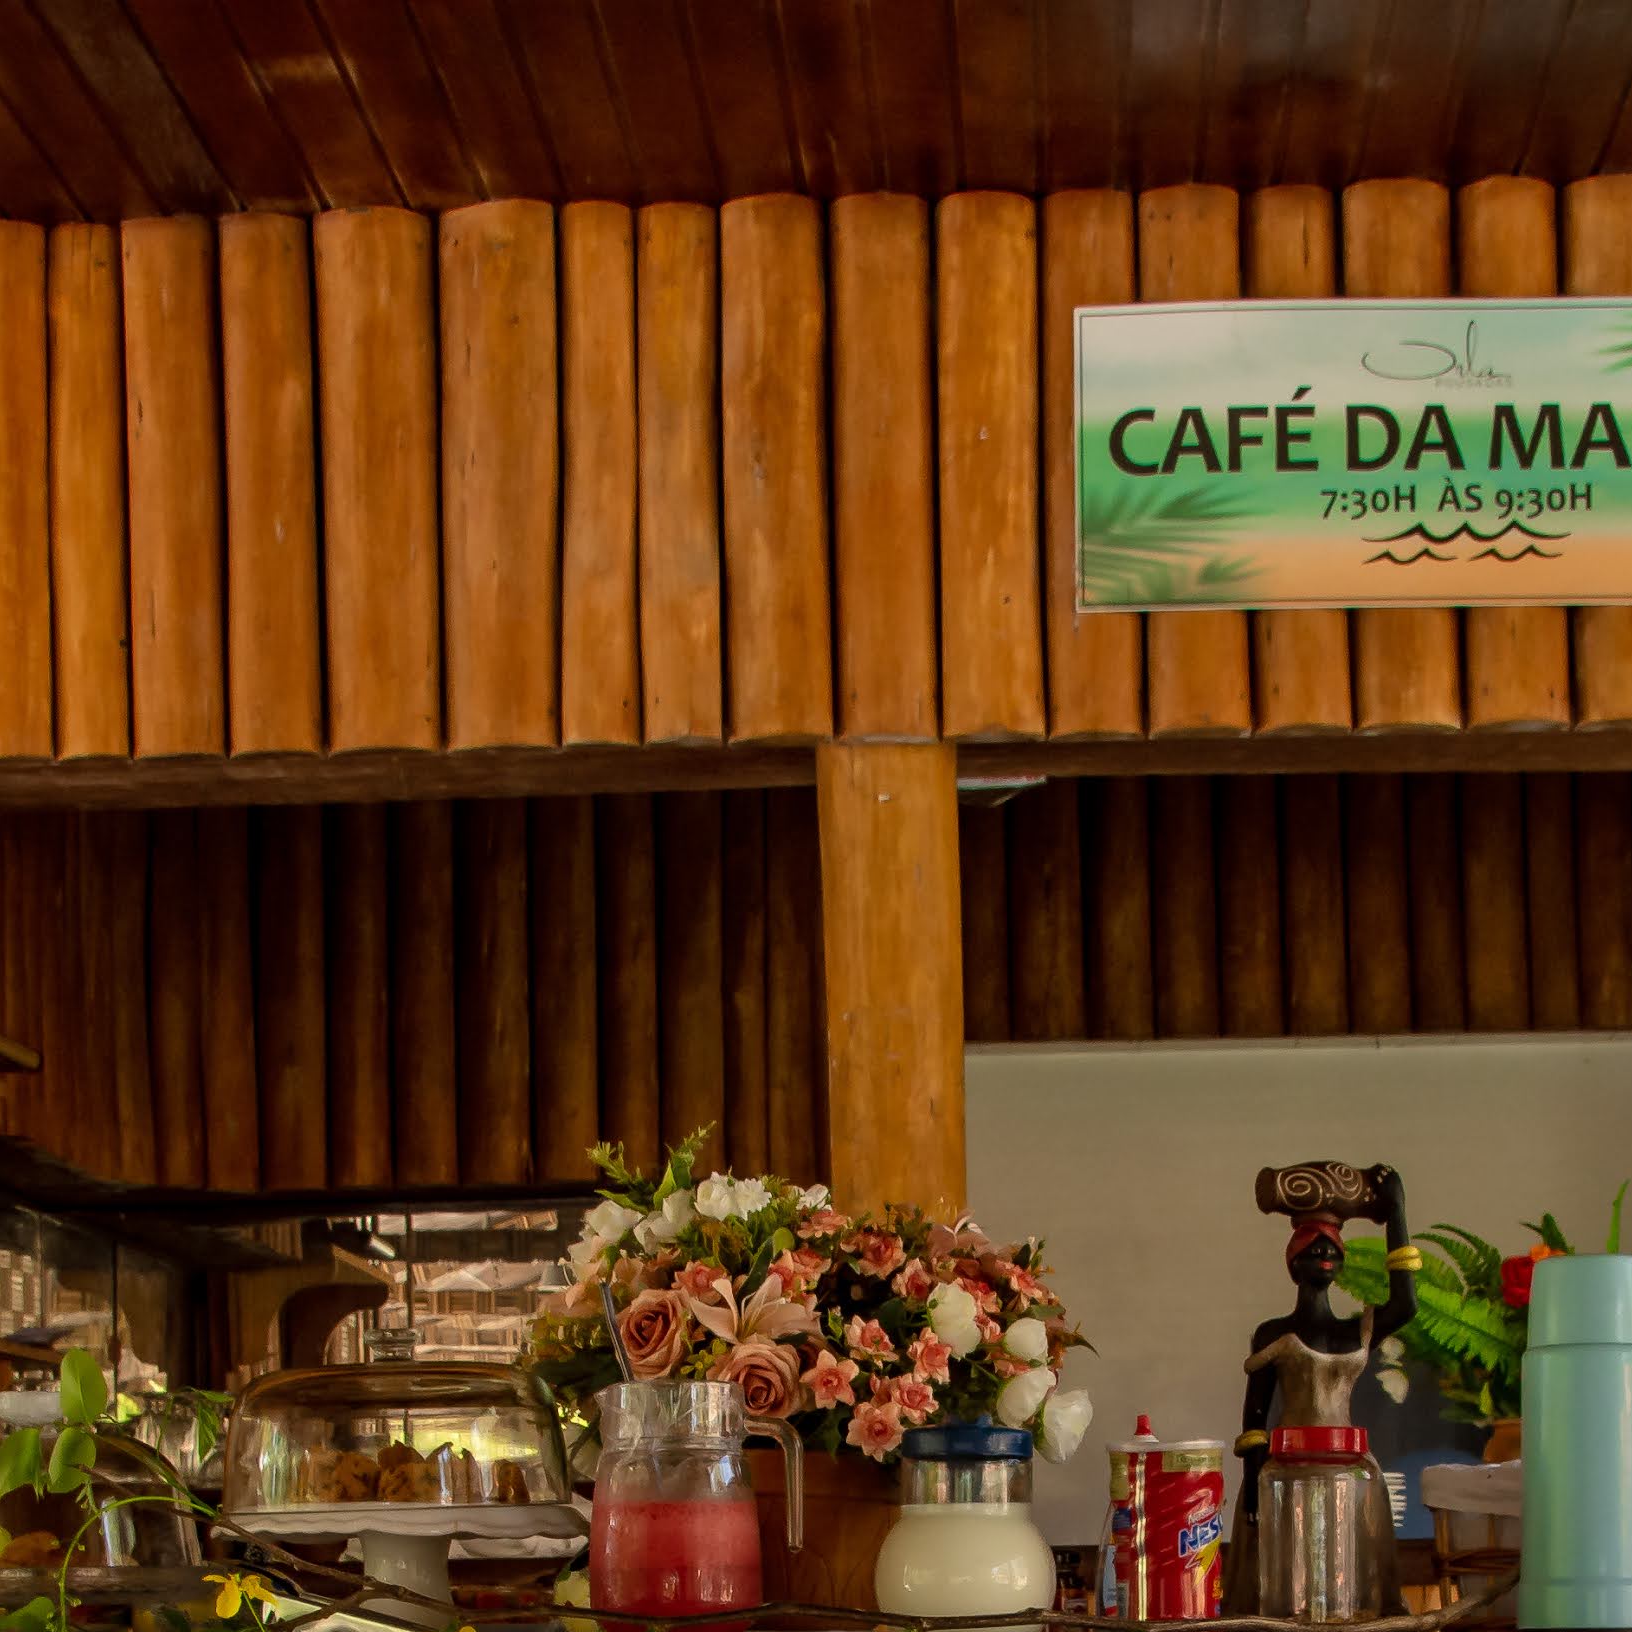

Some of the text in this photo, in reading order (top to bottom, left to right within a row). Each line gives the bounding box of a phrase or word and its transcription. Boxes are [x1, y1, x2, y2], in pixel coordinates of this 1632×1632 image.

[1108, 385, 1319, 476] CAFÉ
[1346, 404, 1466, 471] DA
[1320, 476, 1592, 520] 7:30H ÀS 9:30H
